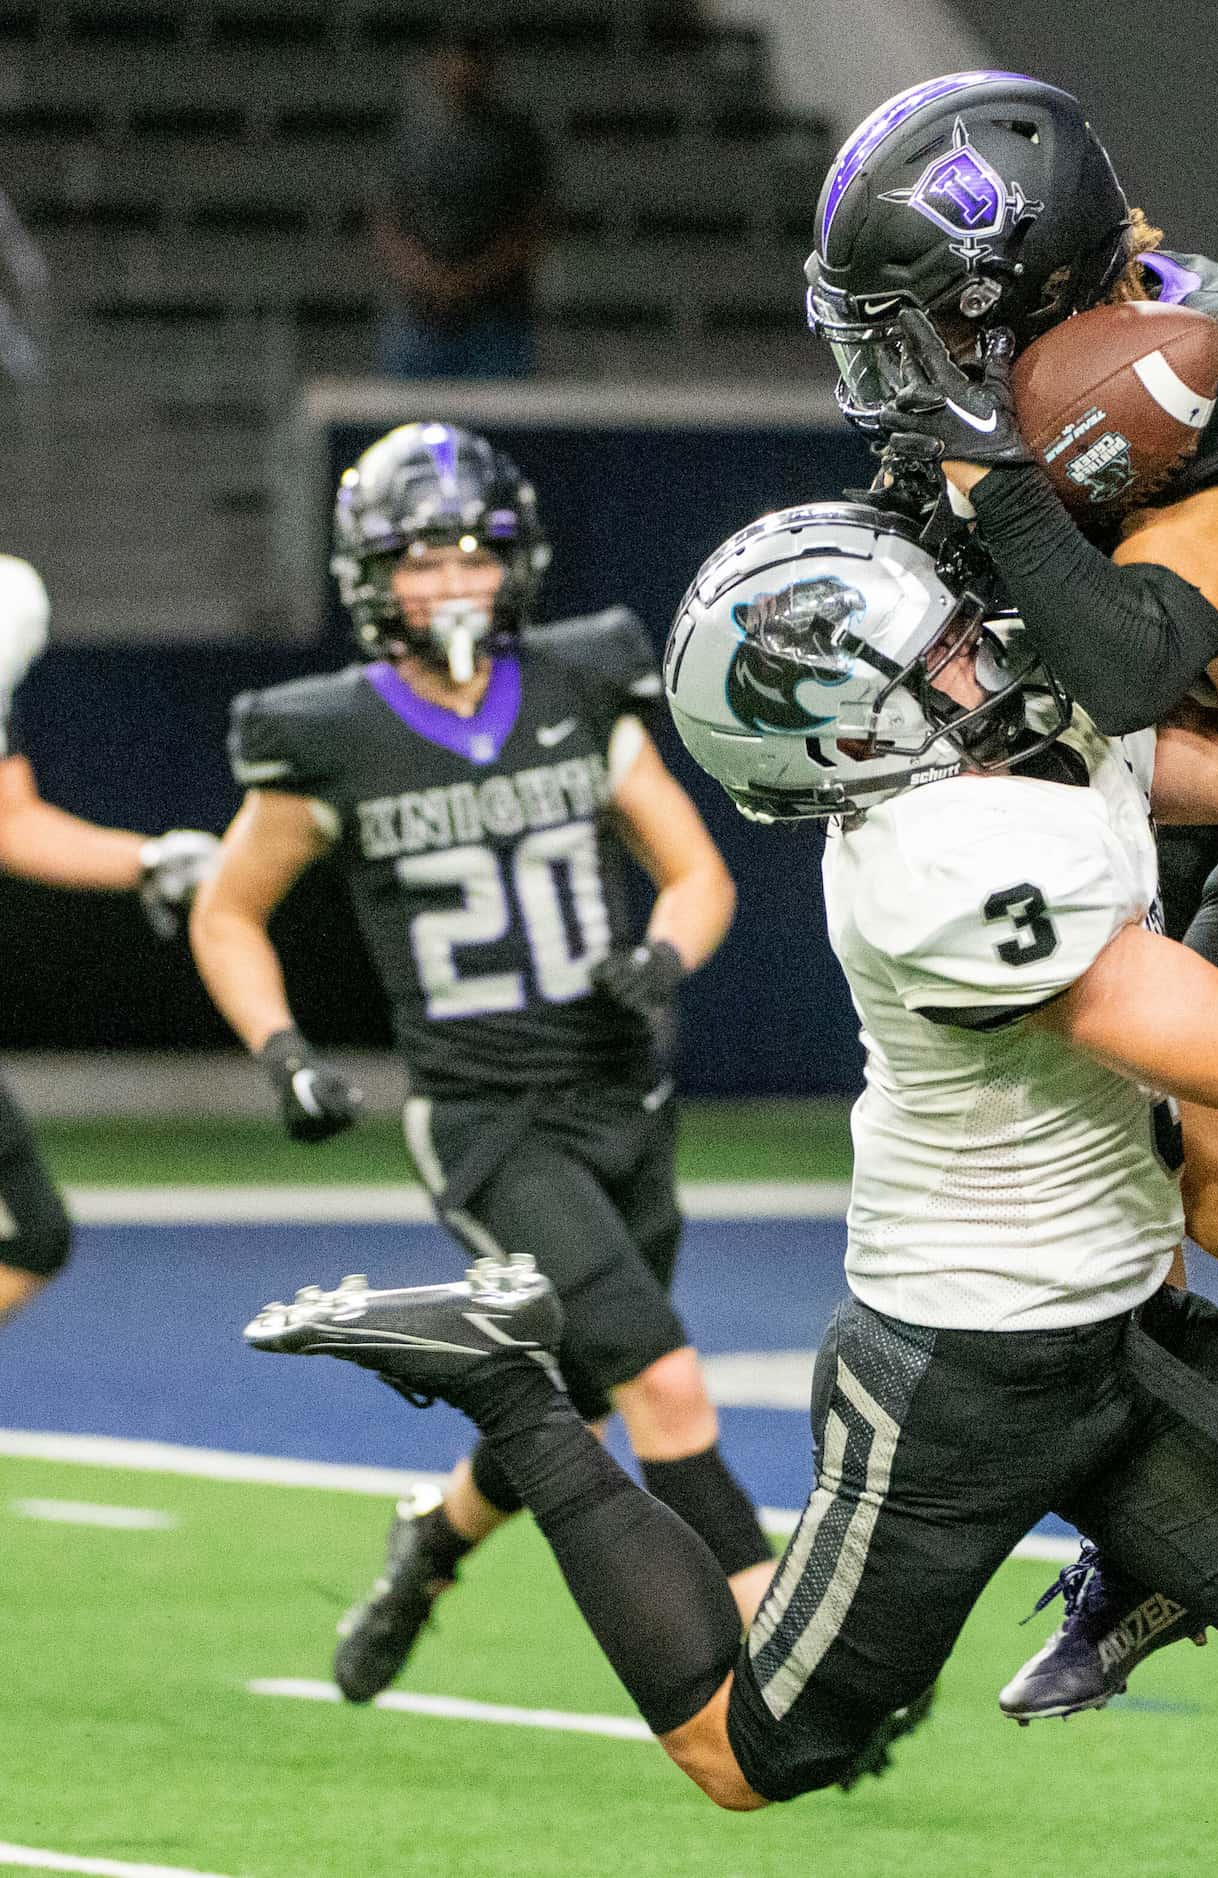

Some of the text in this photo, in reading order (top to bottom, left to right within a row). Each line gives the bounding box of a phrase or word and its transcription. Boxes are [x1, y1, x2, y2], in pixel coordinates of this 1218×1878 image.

[910, 762, 961, 785] schutt
[394, 817, 613, 1021] 20
[982, 881, 1060, 968] 3
